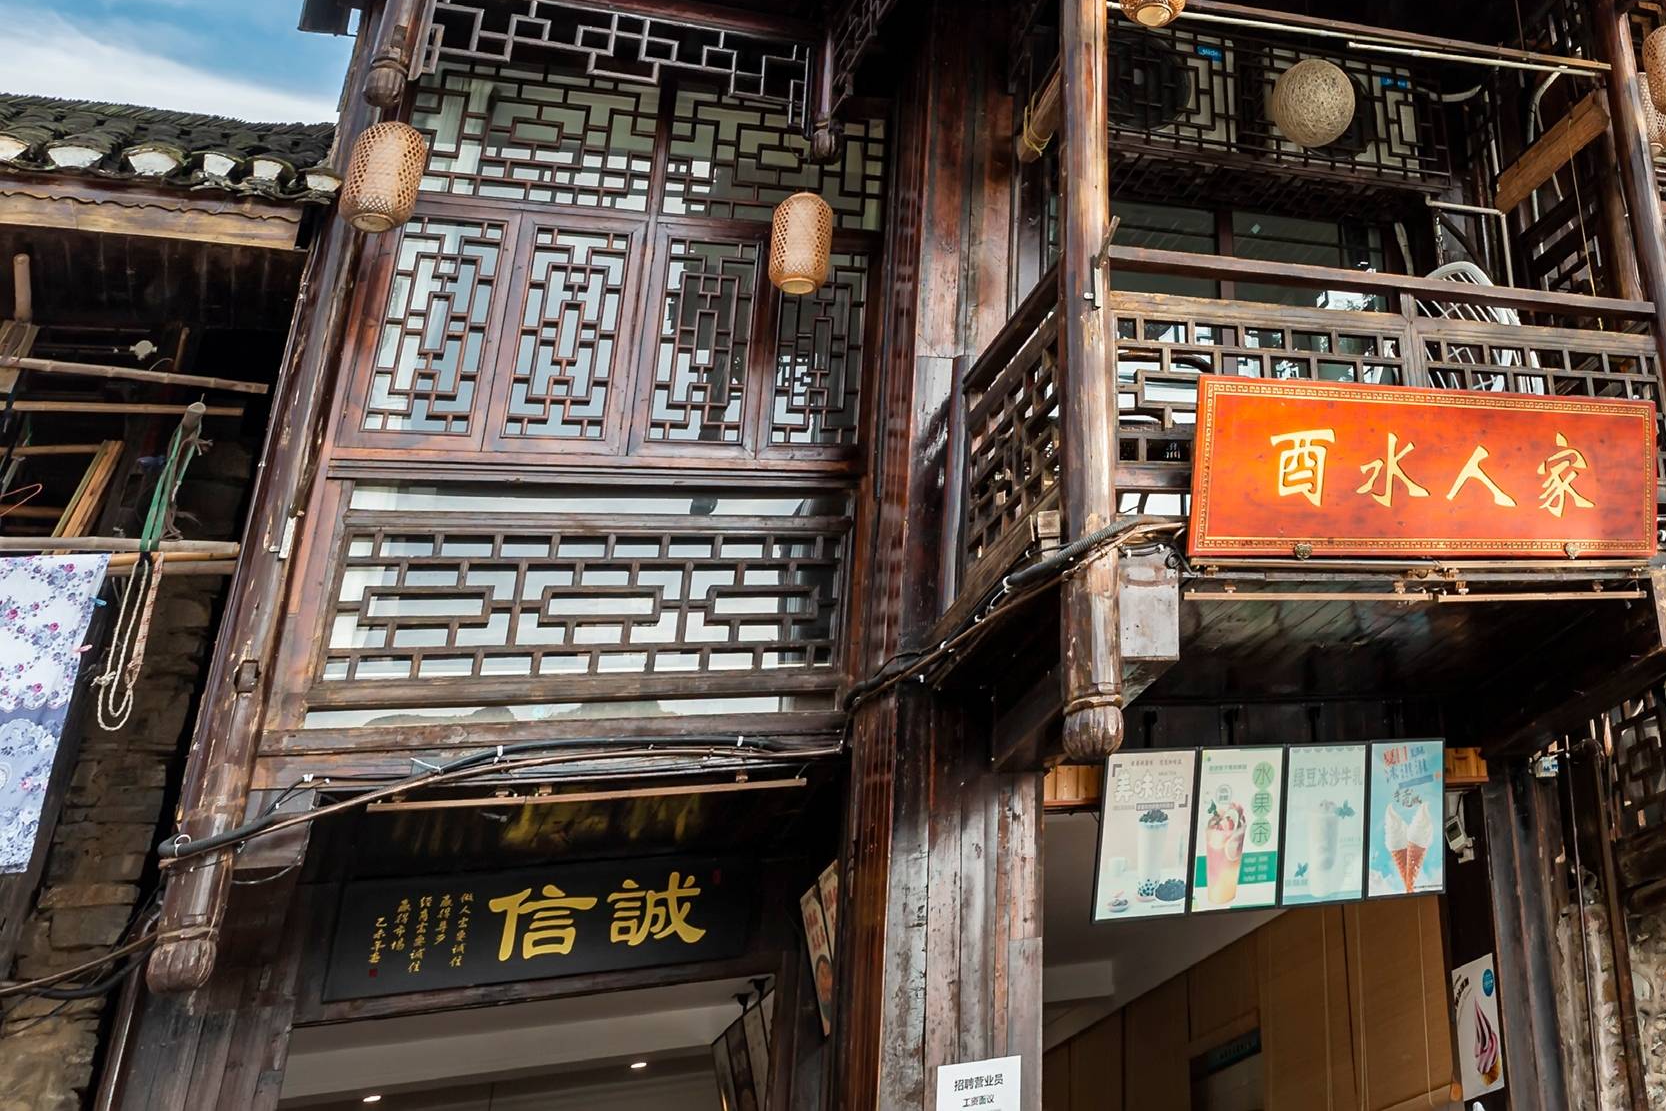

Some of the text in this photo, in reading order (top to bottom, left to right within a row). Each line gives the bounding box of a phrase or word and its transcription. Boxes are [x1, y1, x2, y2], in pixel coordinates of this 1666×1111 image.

[1270, 427, 1597, 518] 酉水人家
[1293, 766, 1364, 788] 绿豆冰沙牛乳
[1251, 765, 1273, 844] 水果茶
[953, 1073, 1004, 1092] 招聘营业员
[962, 1094, 995, 1108] 工资面议
